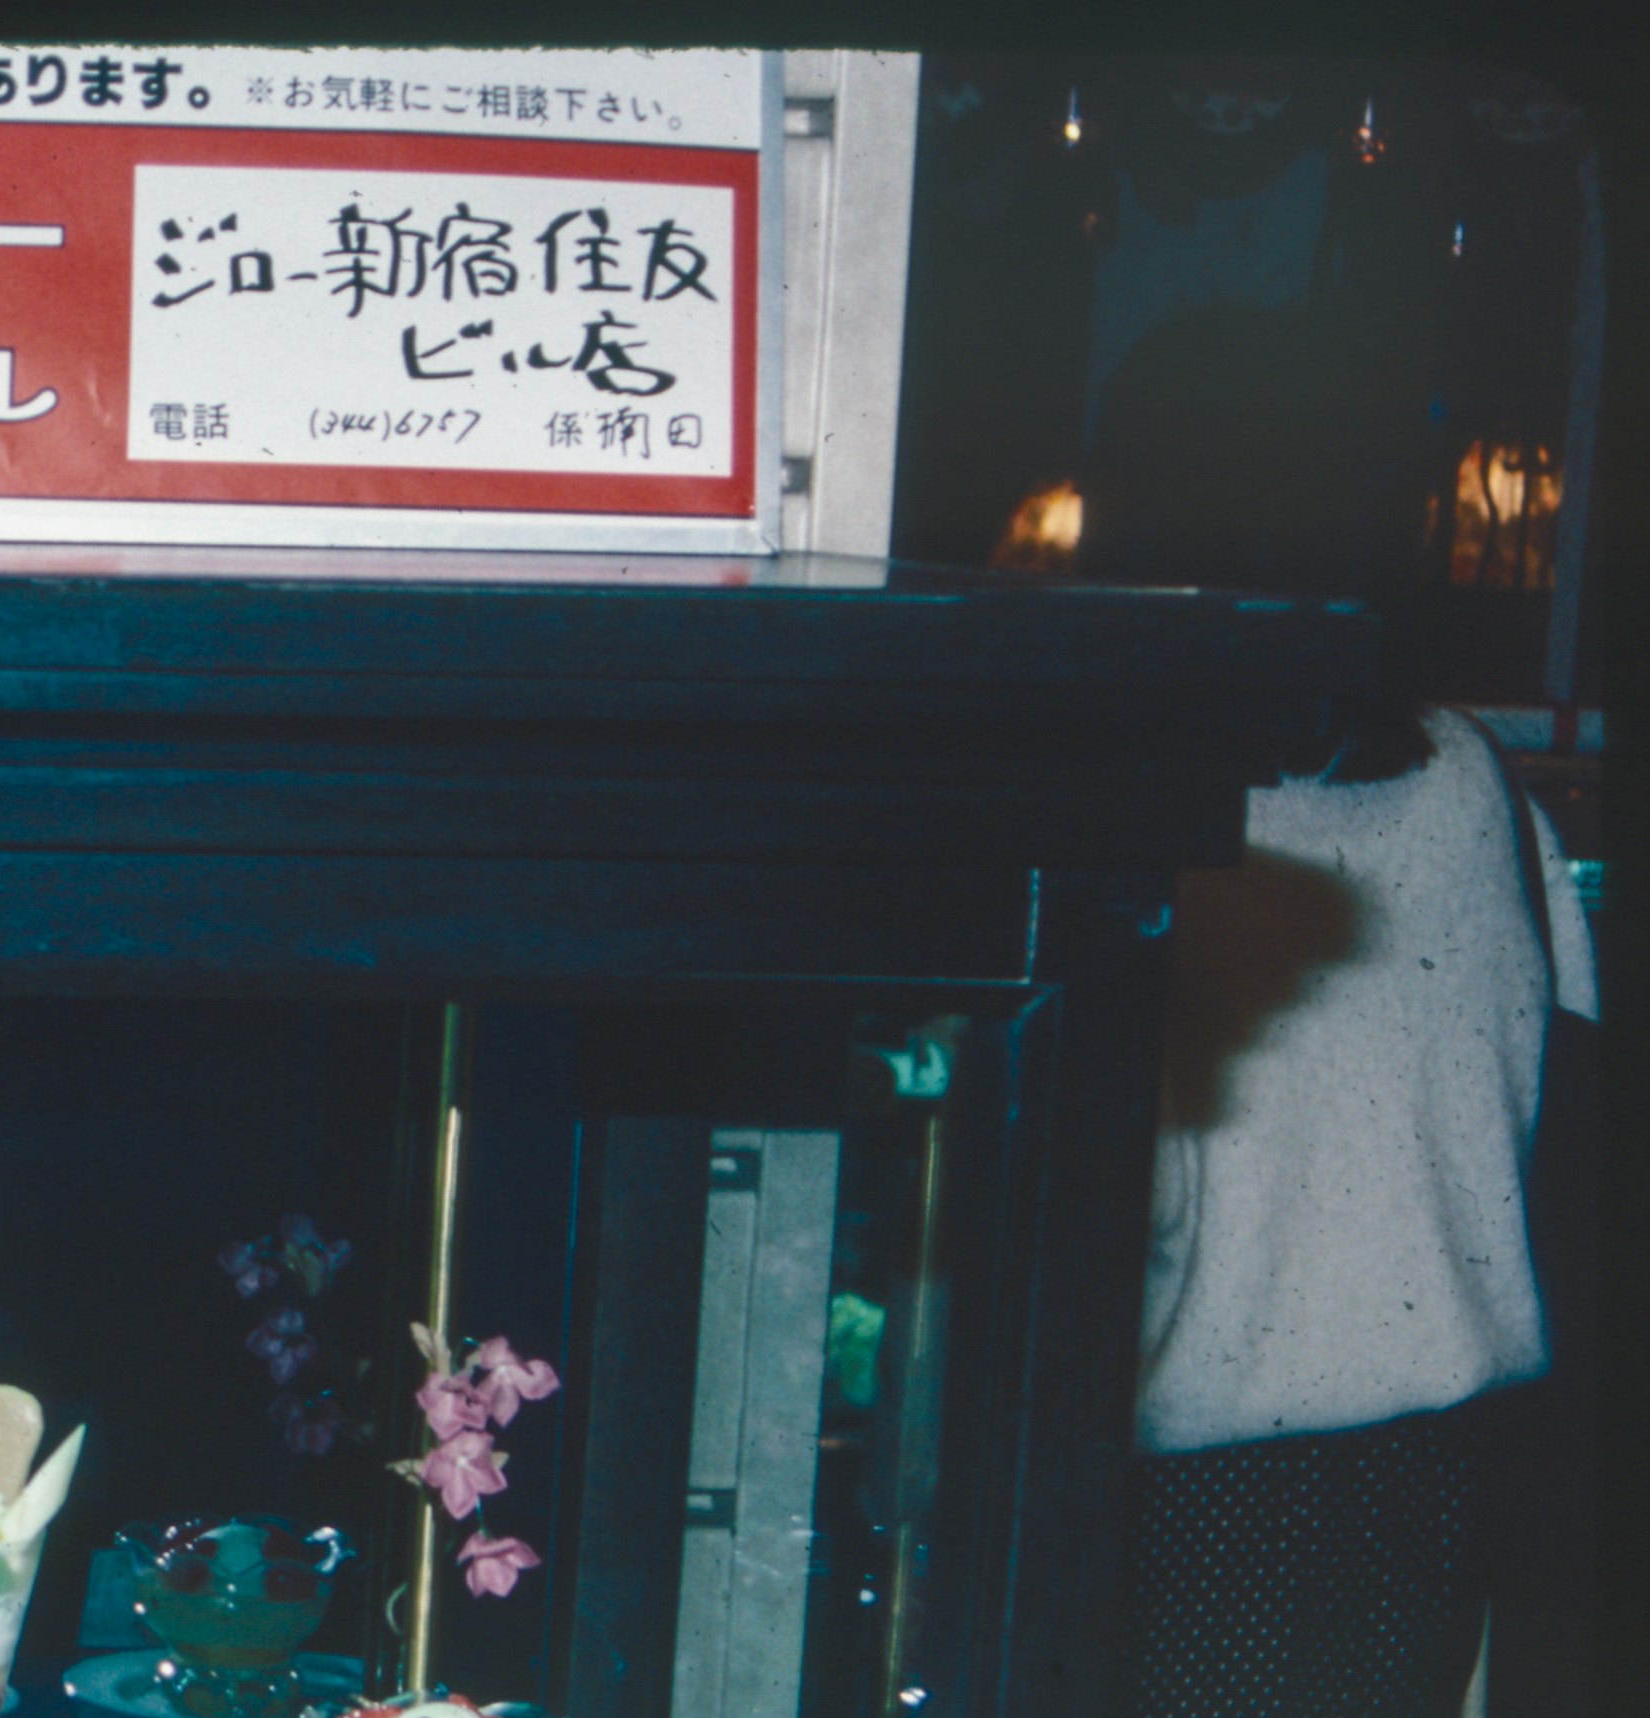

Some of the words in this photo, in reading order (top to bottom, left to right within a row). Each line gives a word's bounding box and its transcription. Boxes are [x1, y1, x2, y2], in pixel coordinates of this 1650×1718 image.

[151, 201, 719, 318] ジロー新宿住友
[400, 310, 677, 397] ビル店
[149, 402, 231, 442] 電話
[308, 409, 483, 445] (344)6757
